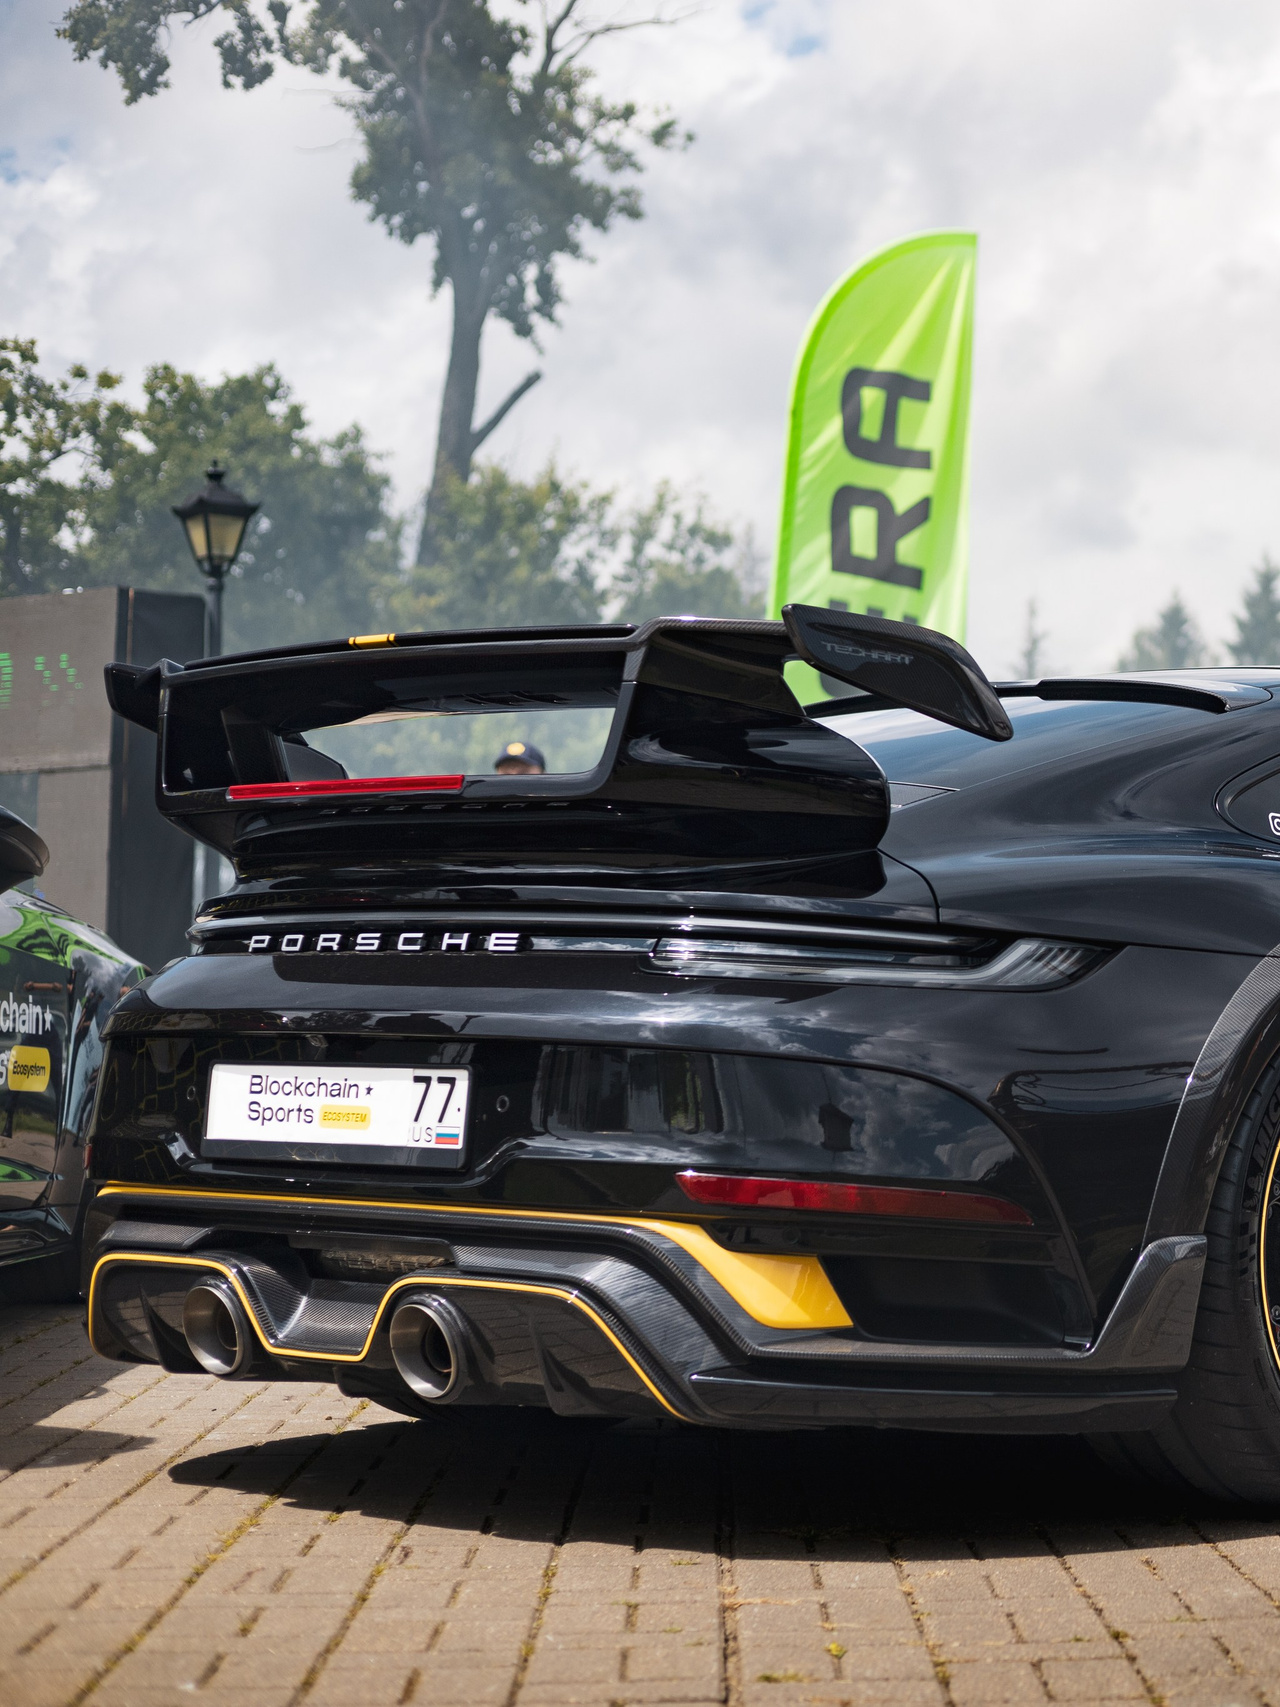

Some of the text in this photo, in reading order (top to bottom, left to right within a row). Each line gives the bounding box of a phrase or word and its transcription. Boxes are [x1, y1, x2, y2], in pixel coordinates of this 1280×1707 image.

[248, 932, 521, 952] PORSCHE
[0, 992, 42, 1035] chain
[12, 1060, 46, 1078] Ecosystem
[249, 1073, 359, 1099] Blockchain
[412, 1075, 457, 1124] 77
[247, 1100, 367, 1126] Sports ECOSYSTEM
[407, 1126, 433, 1143] US
